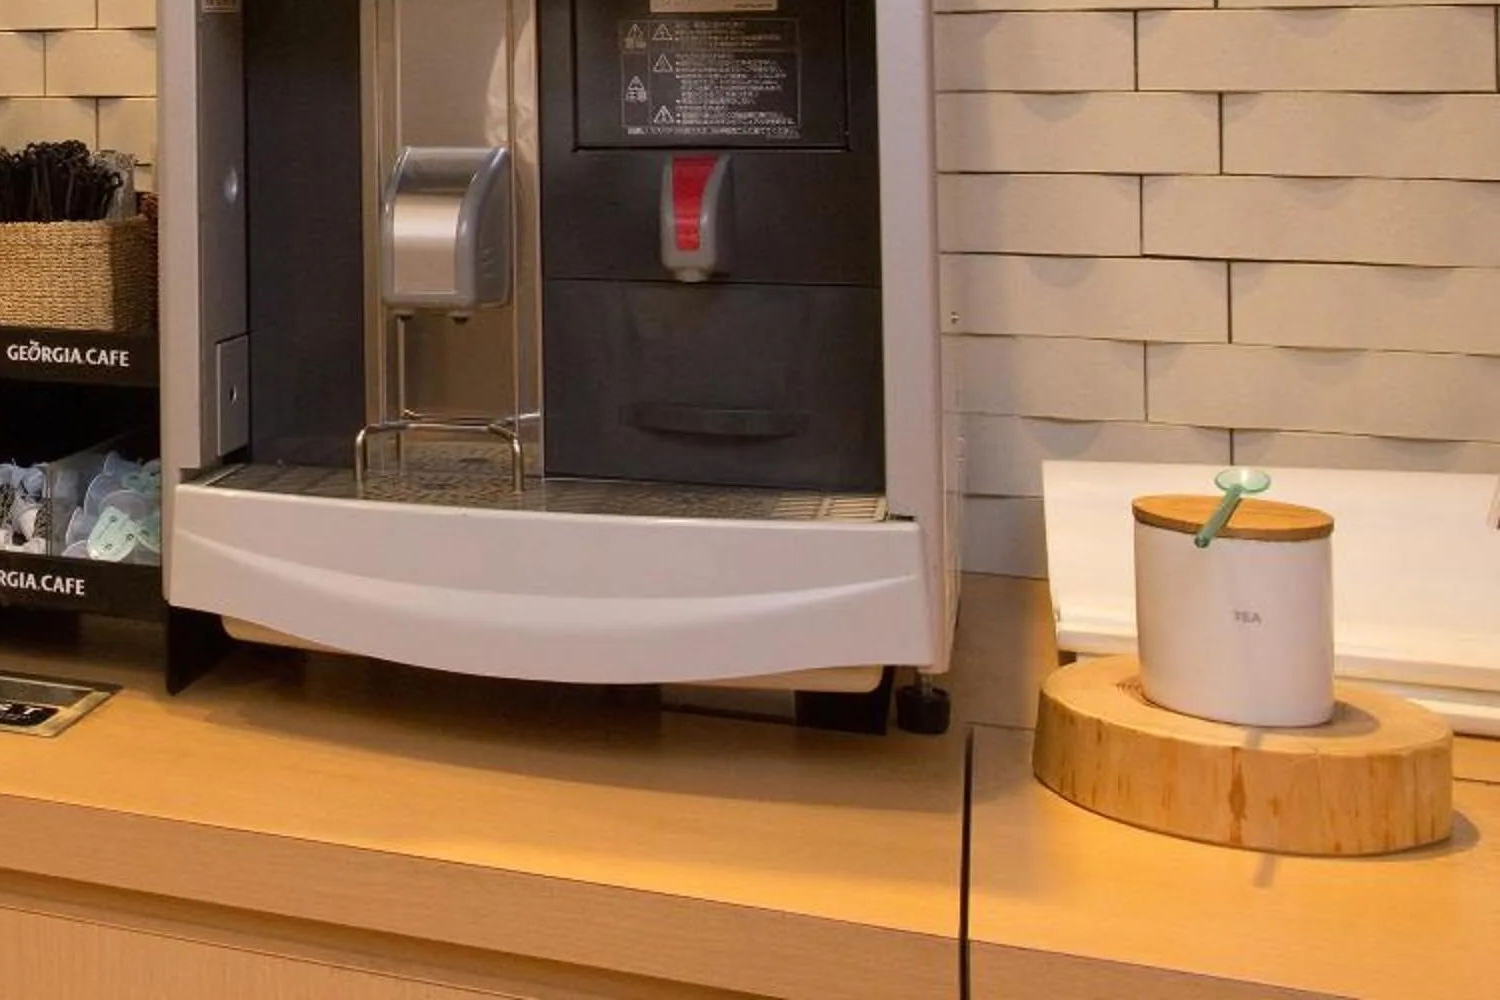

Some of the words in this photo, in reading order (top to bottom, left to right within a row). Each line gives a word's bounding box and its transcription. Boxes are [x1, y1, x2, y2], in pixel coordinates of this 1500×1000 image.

[85, 349, 130, 368] CAFE
[41, 574, 85, 596] CAFE
[1233, 609, 1262, 624] TEA
